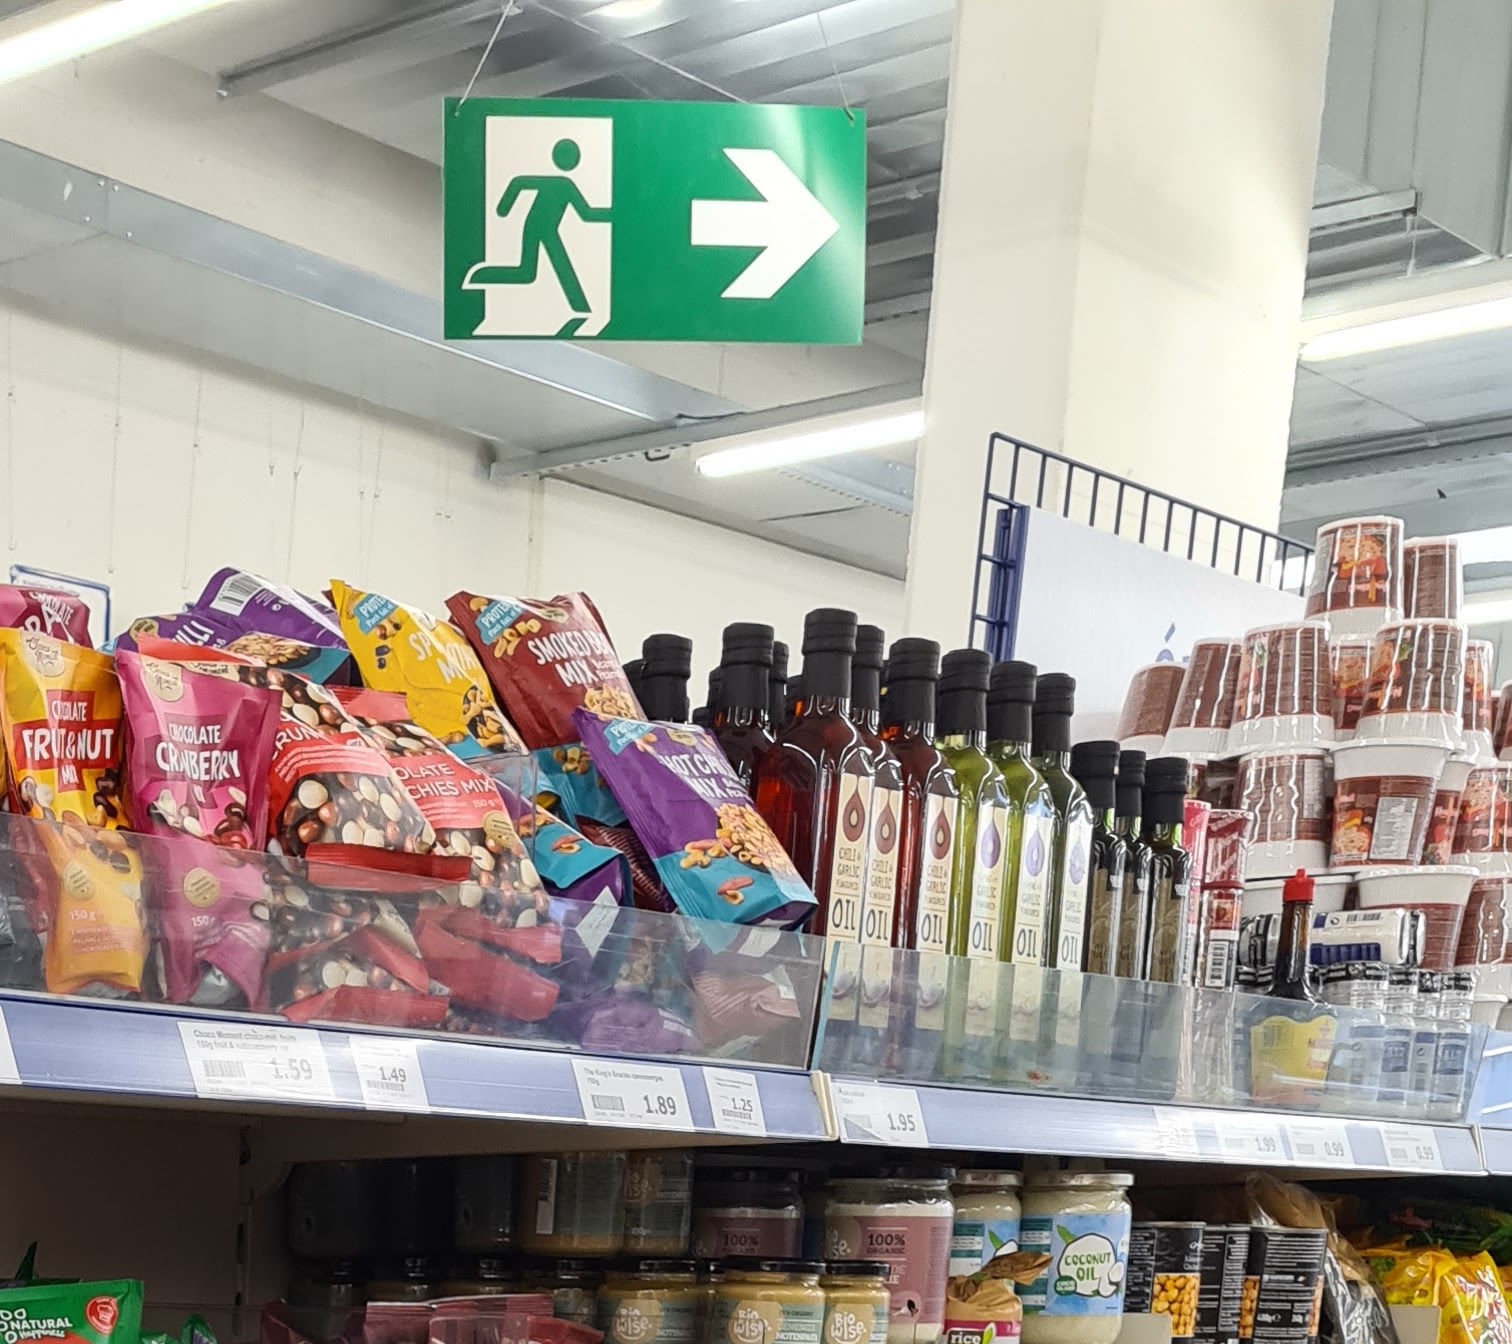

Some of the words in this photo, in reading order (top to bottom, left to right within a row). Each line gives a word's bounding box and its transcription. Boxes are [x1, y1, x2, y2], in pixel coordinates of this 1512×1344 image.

[528, 630, 591, 666] SMOKED
[555, 658, 598, 687] MIX
[168, 721, 222, 745] CHOCOLATE
[155, 749, 240, 781] CRANBERRY
[839, 847, 856, 862] CHILI
[837, 862, 860, 878] GARLIC
[831, 897, 856, 932] OIL
[865, 908, 888, 941] OIL
[921, 913, 943, 945] OIL
[972, 920, 993, 953] OIL
[1016, 927, 1037, 959] OIL
[270, 1056, 313, 1084] 1.59
[379, 1064, 407, 1083] 1.49
[644, 1094, 677, 1117] 1.89
[732, 1095, 754, 1115] 1.25
[888, 1113, 917, 1133] 1.95
[1323, 1140, 1345, 1158] 0.99
[867, 1233, 906, 1248] 100%
[1064, 1252, 1112, 1267] COCONUT
[9, 1316, 73, 1331] NATURAL
